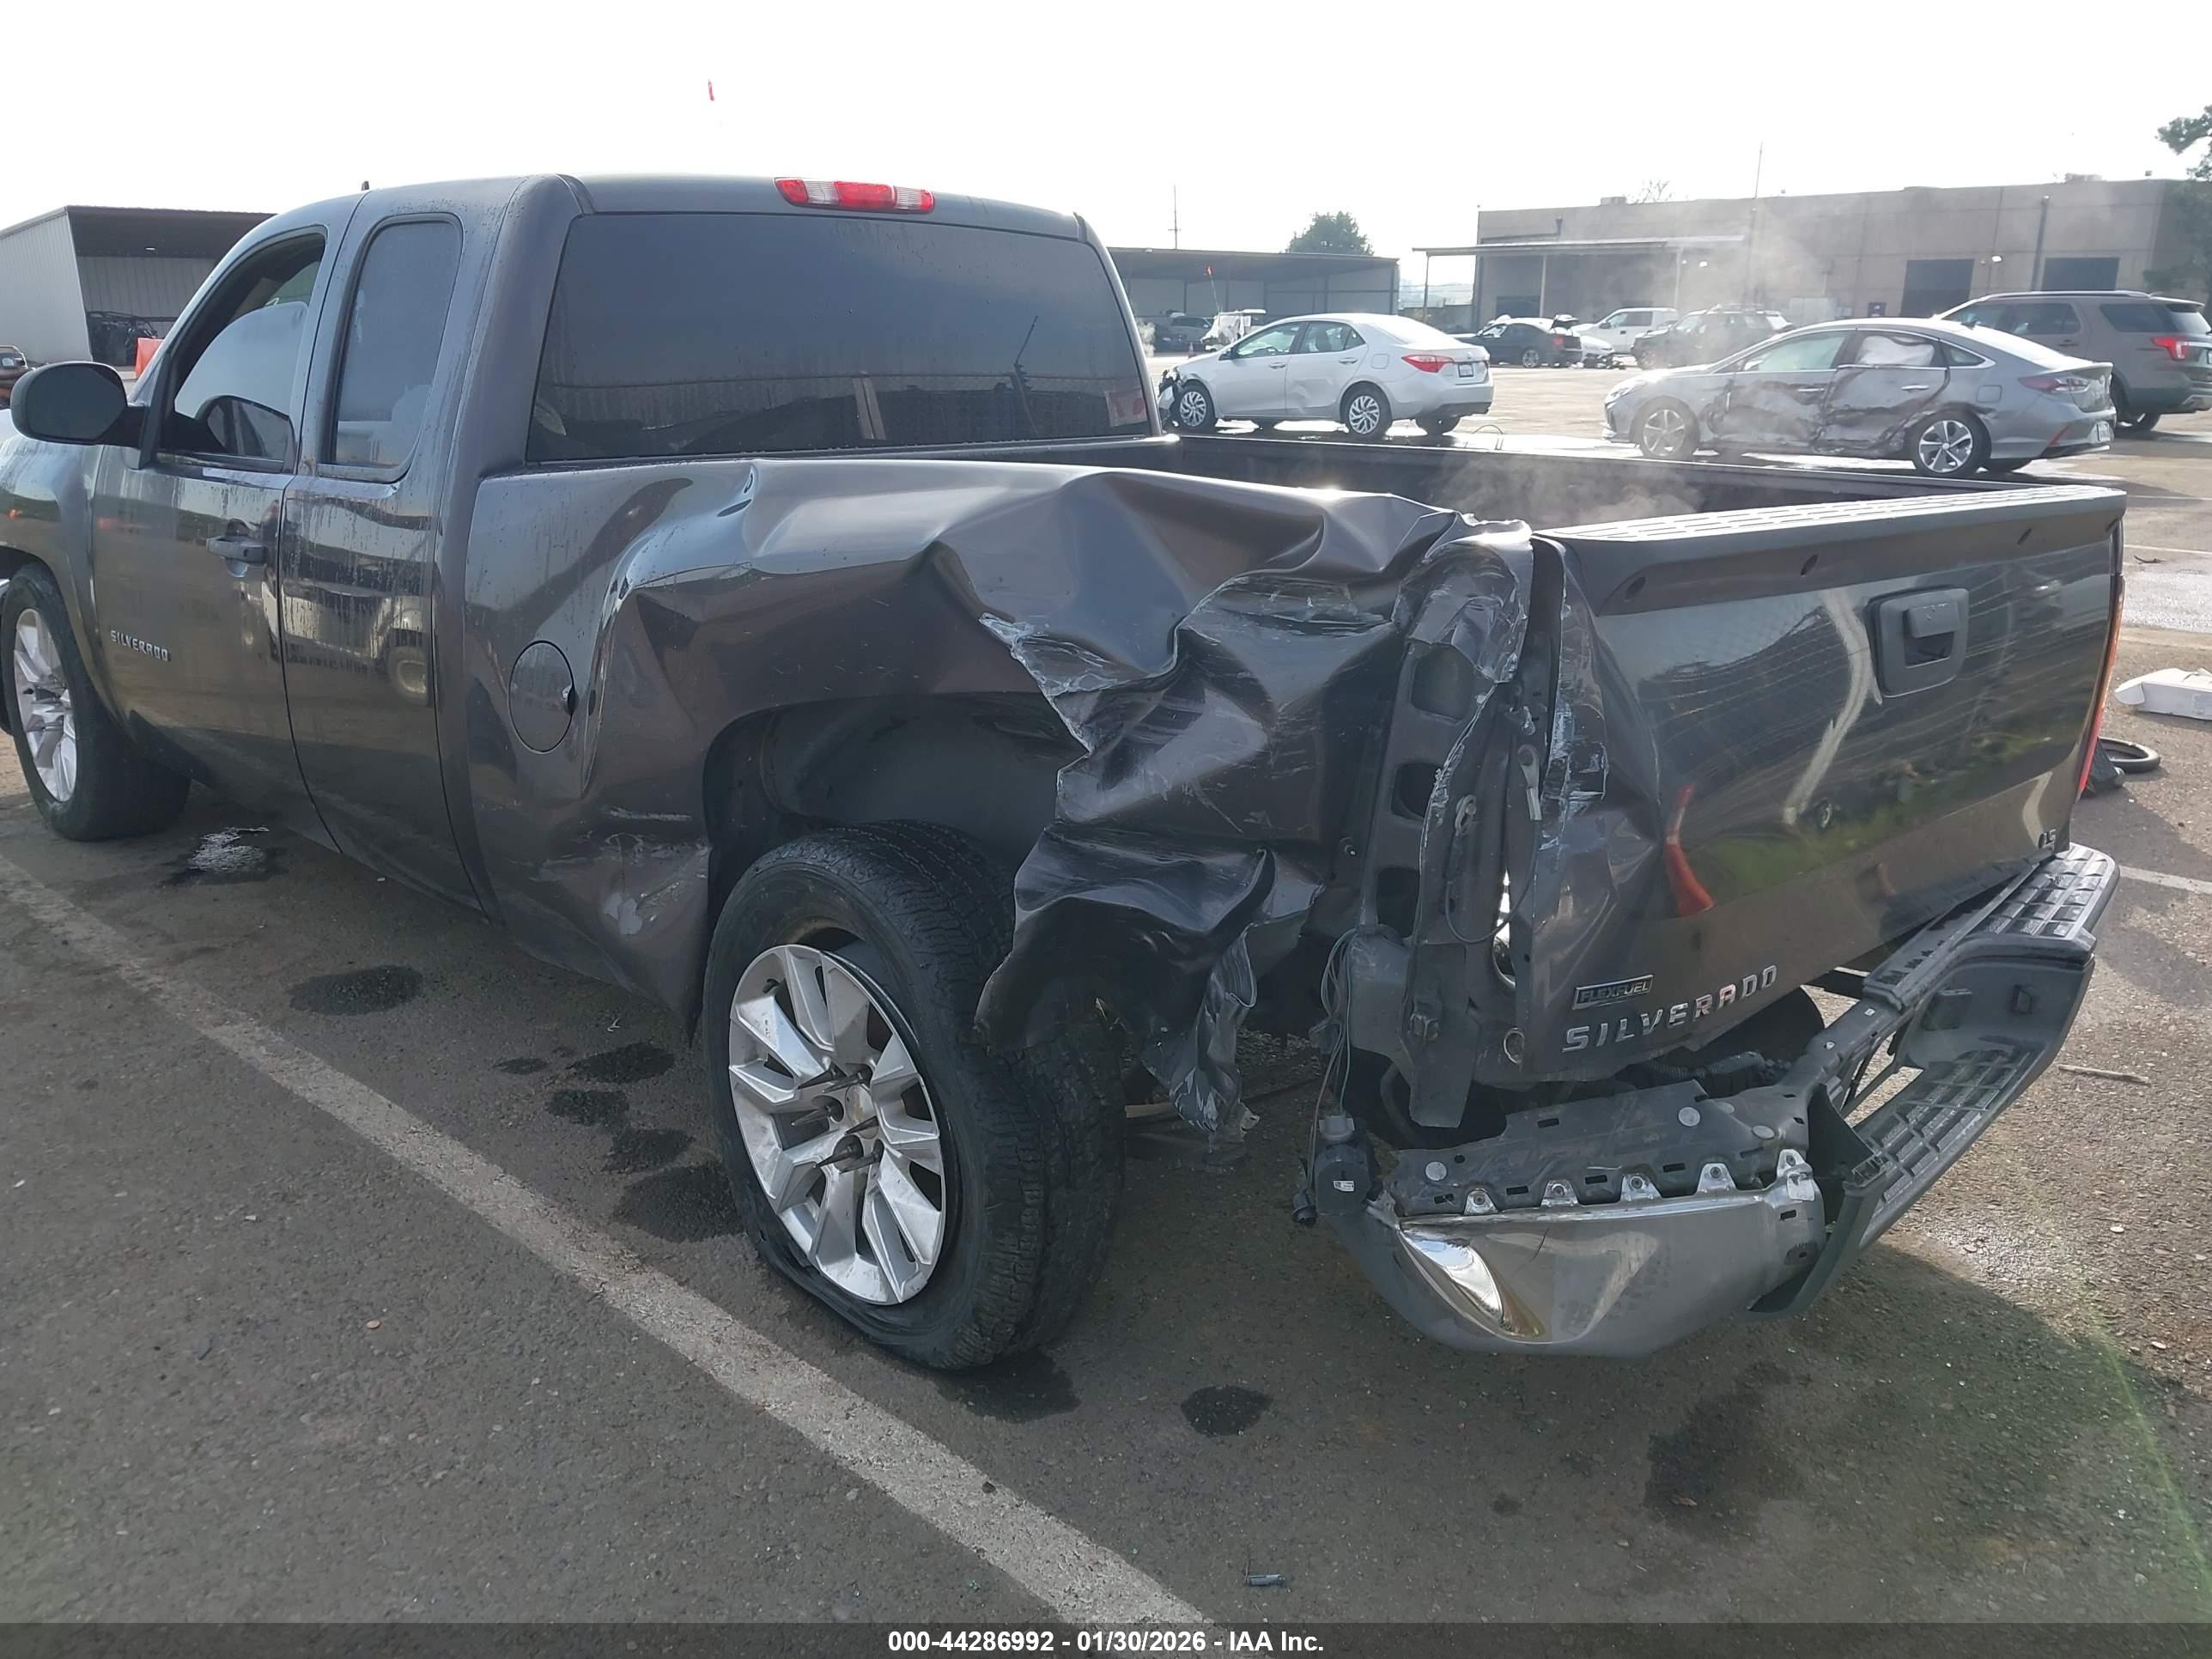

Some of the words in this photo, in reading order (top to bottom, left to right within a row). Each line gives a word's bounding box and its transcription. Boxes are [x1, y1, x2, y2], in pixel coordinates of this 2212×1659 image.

[110, 629, 169, 662] SILVERADO
[1580, 981, 1649, 1003] FLEXFUEL
[1561, 964, 1778, 1054] SILVERADO
